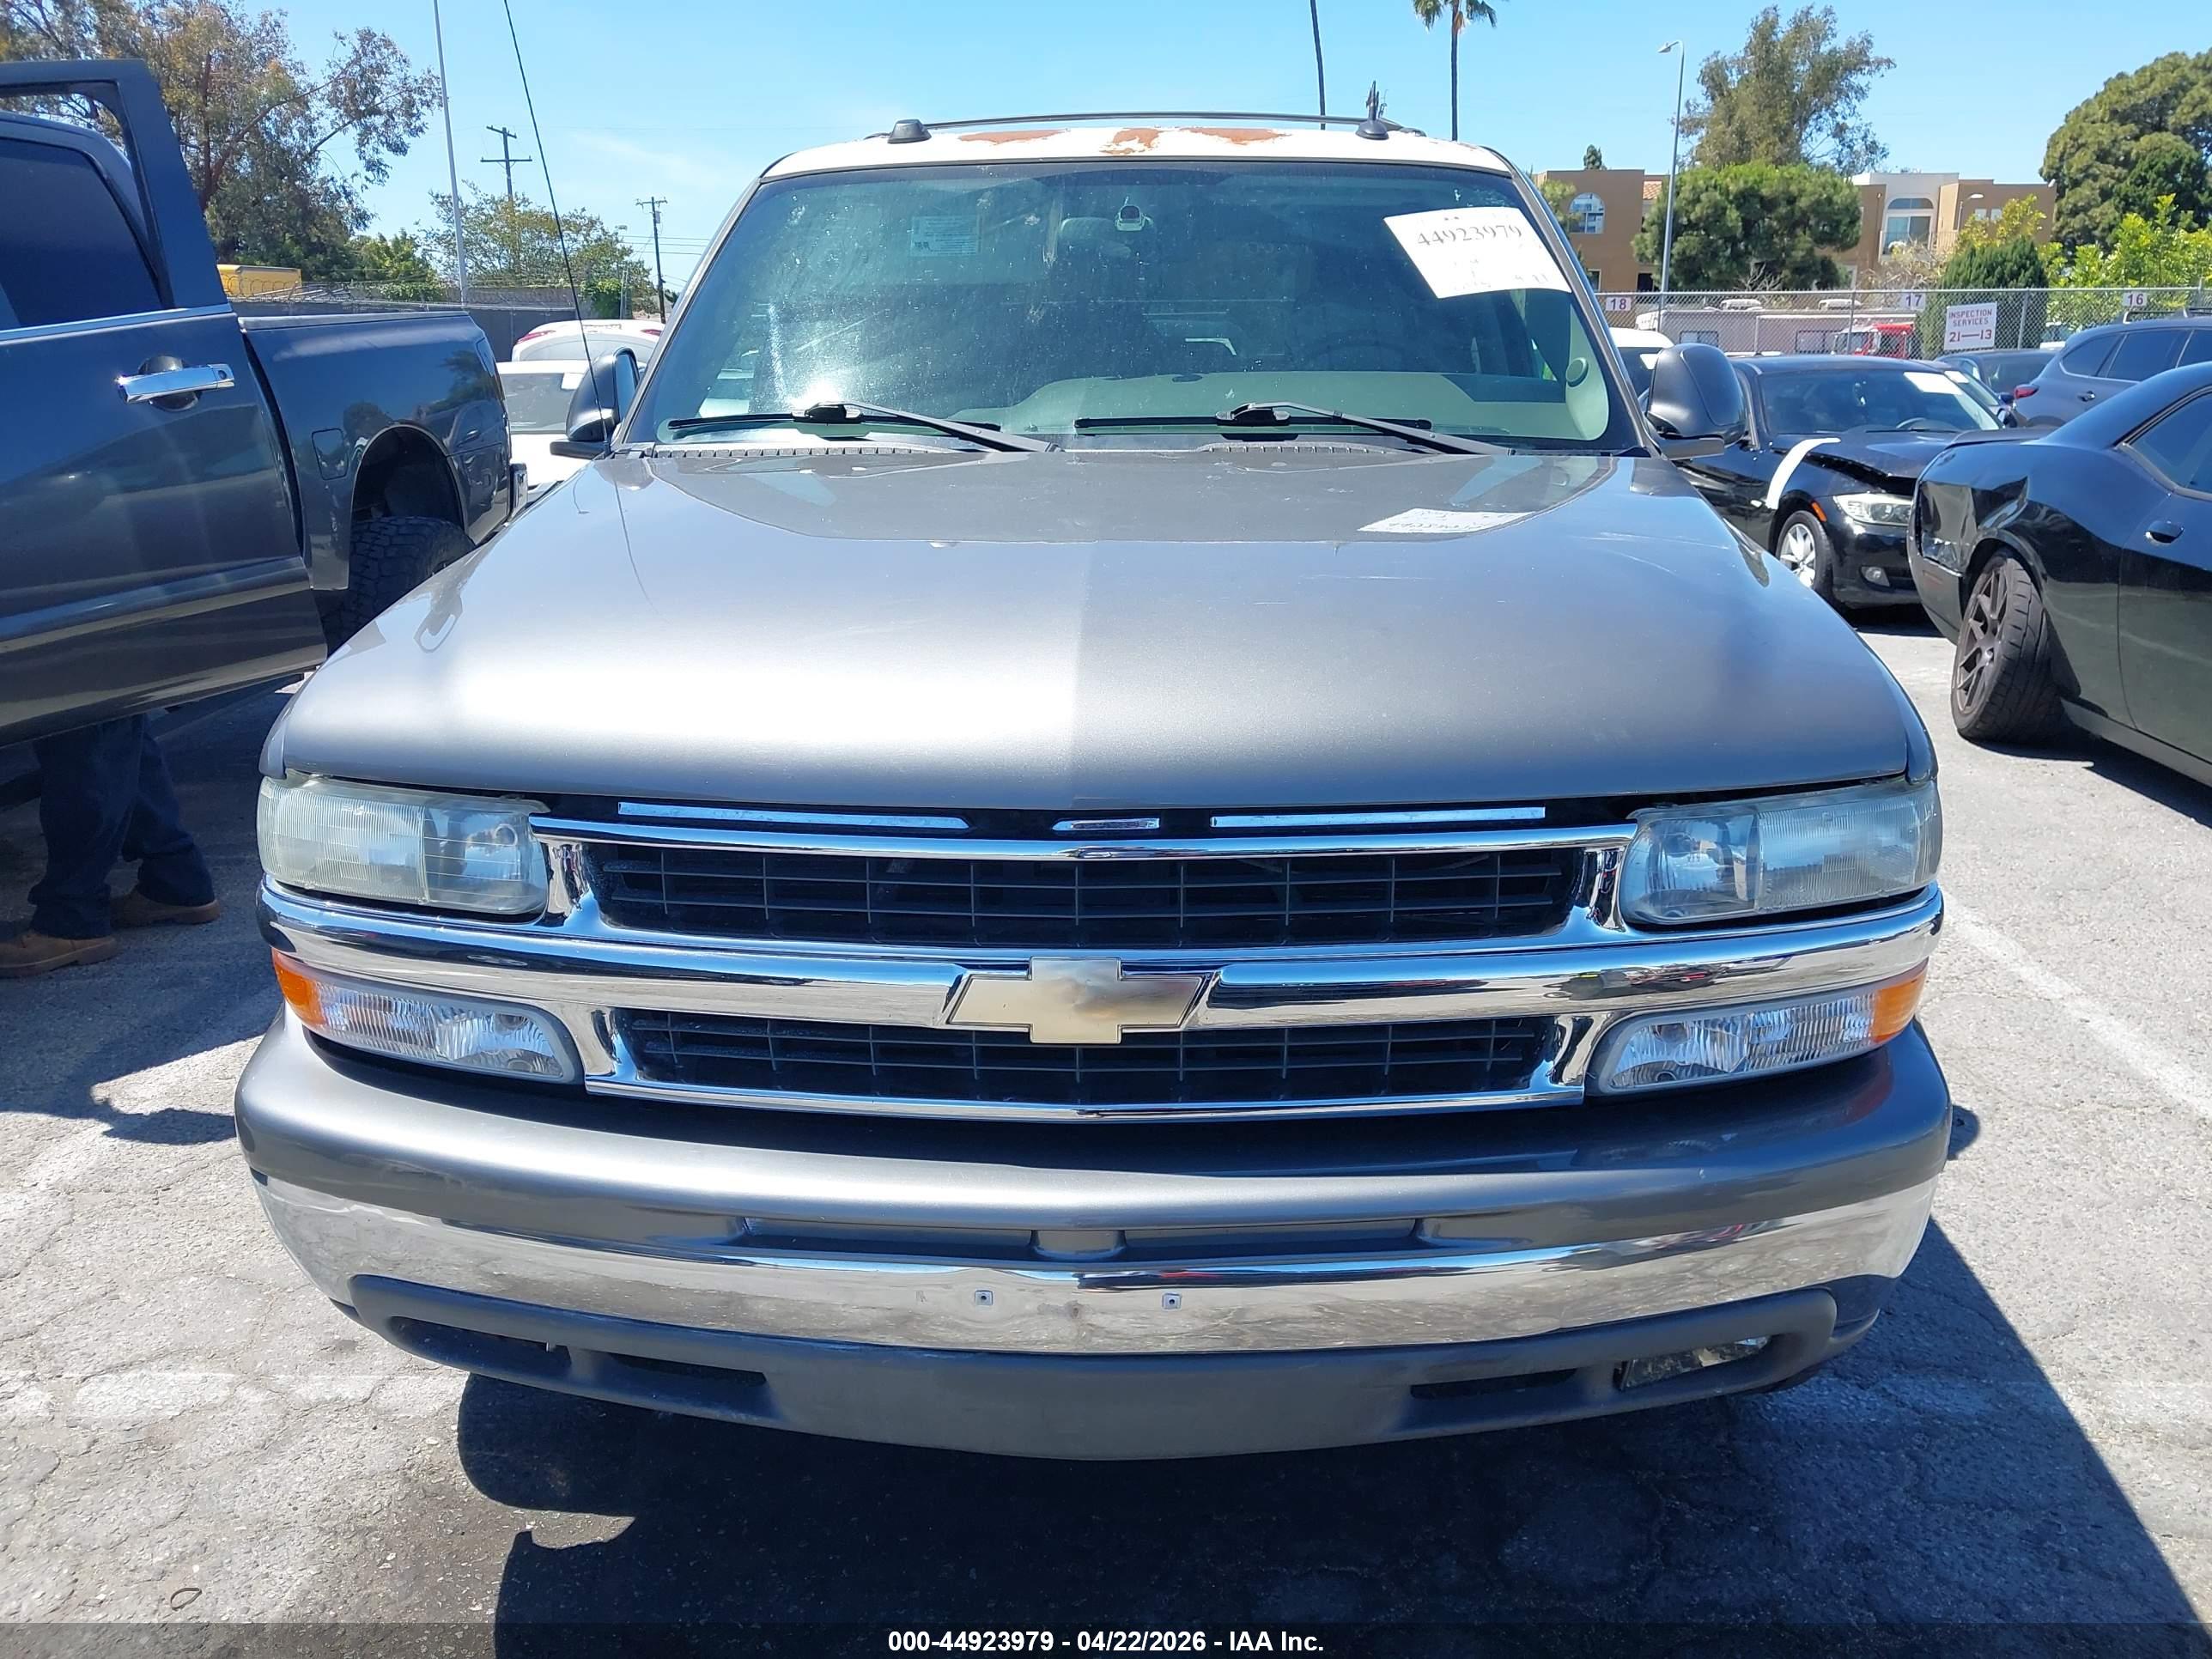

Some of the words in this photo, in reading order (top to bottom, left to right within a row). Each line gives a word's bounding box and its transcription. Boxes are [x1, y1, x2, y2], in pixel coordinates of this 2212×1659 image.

[1417, 225, 1522, 246] 44923979
[1610, 298, 1627, 310] 18
[1905, 295, 1923, 307] 17
[2128, 294, 2144, 306] 16
[1948, 309, 1992, 319] INSPECTION
[1953, 317, 1989, 326] SERVICES
